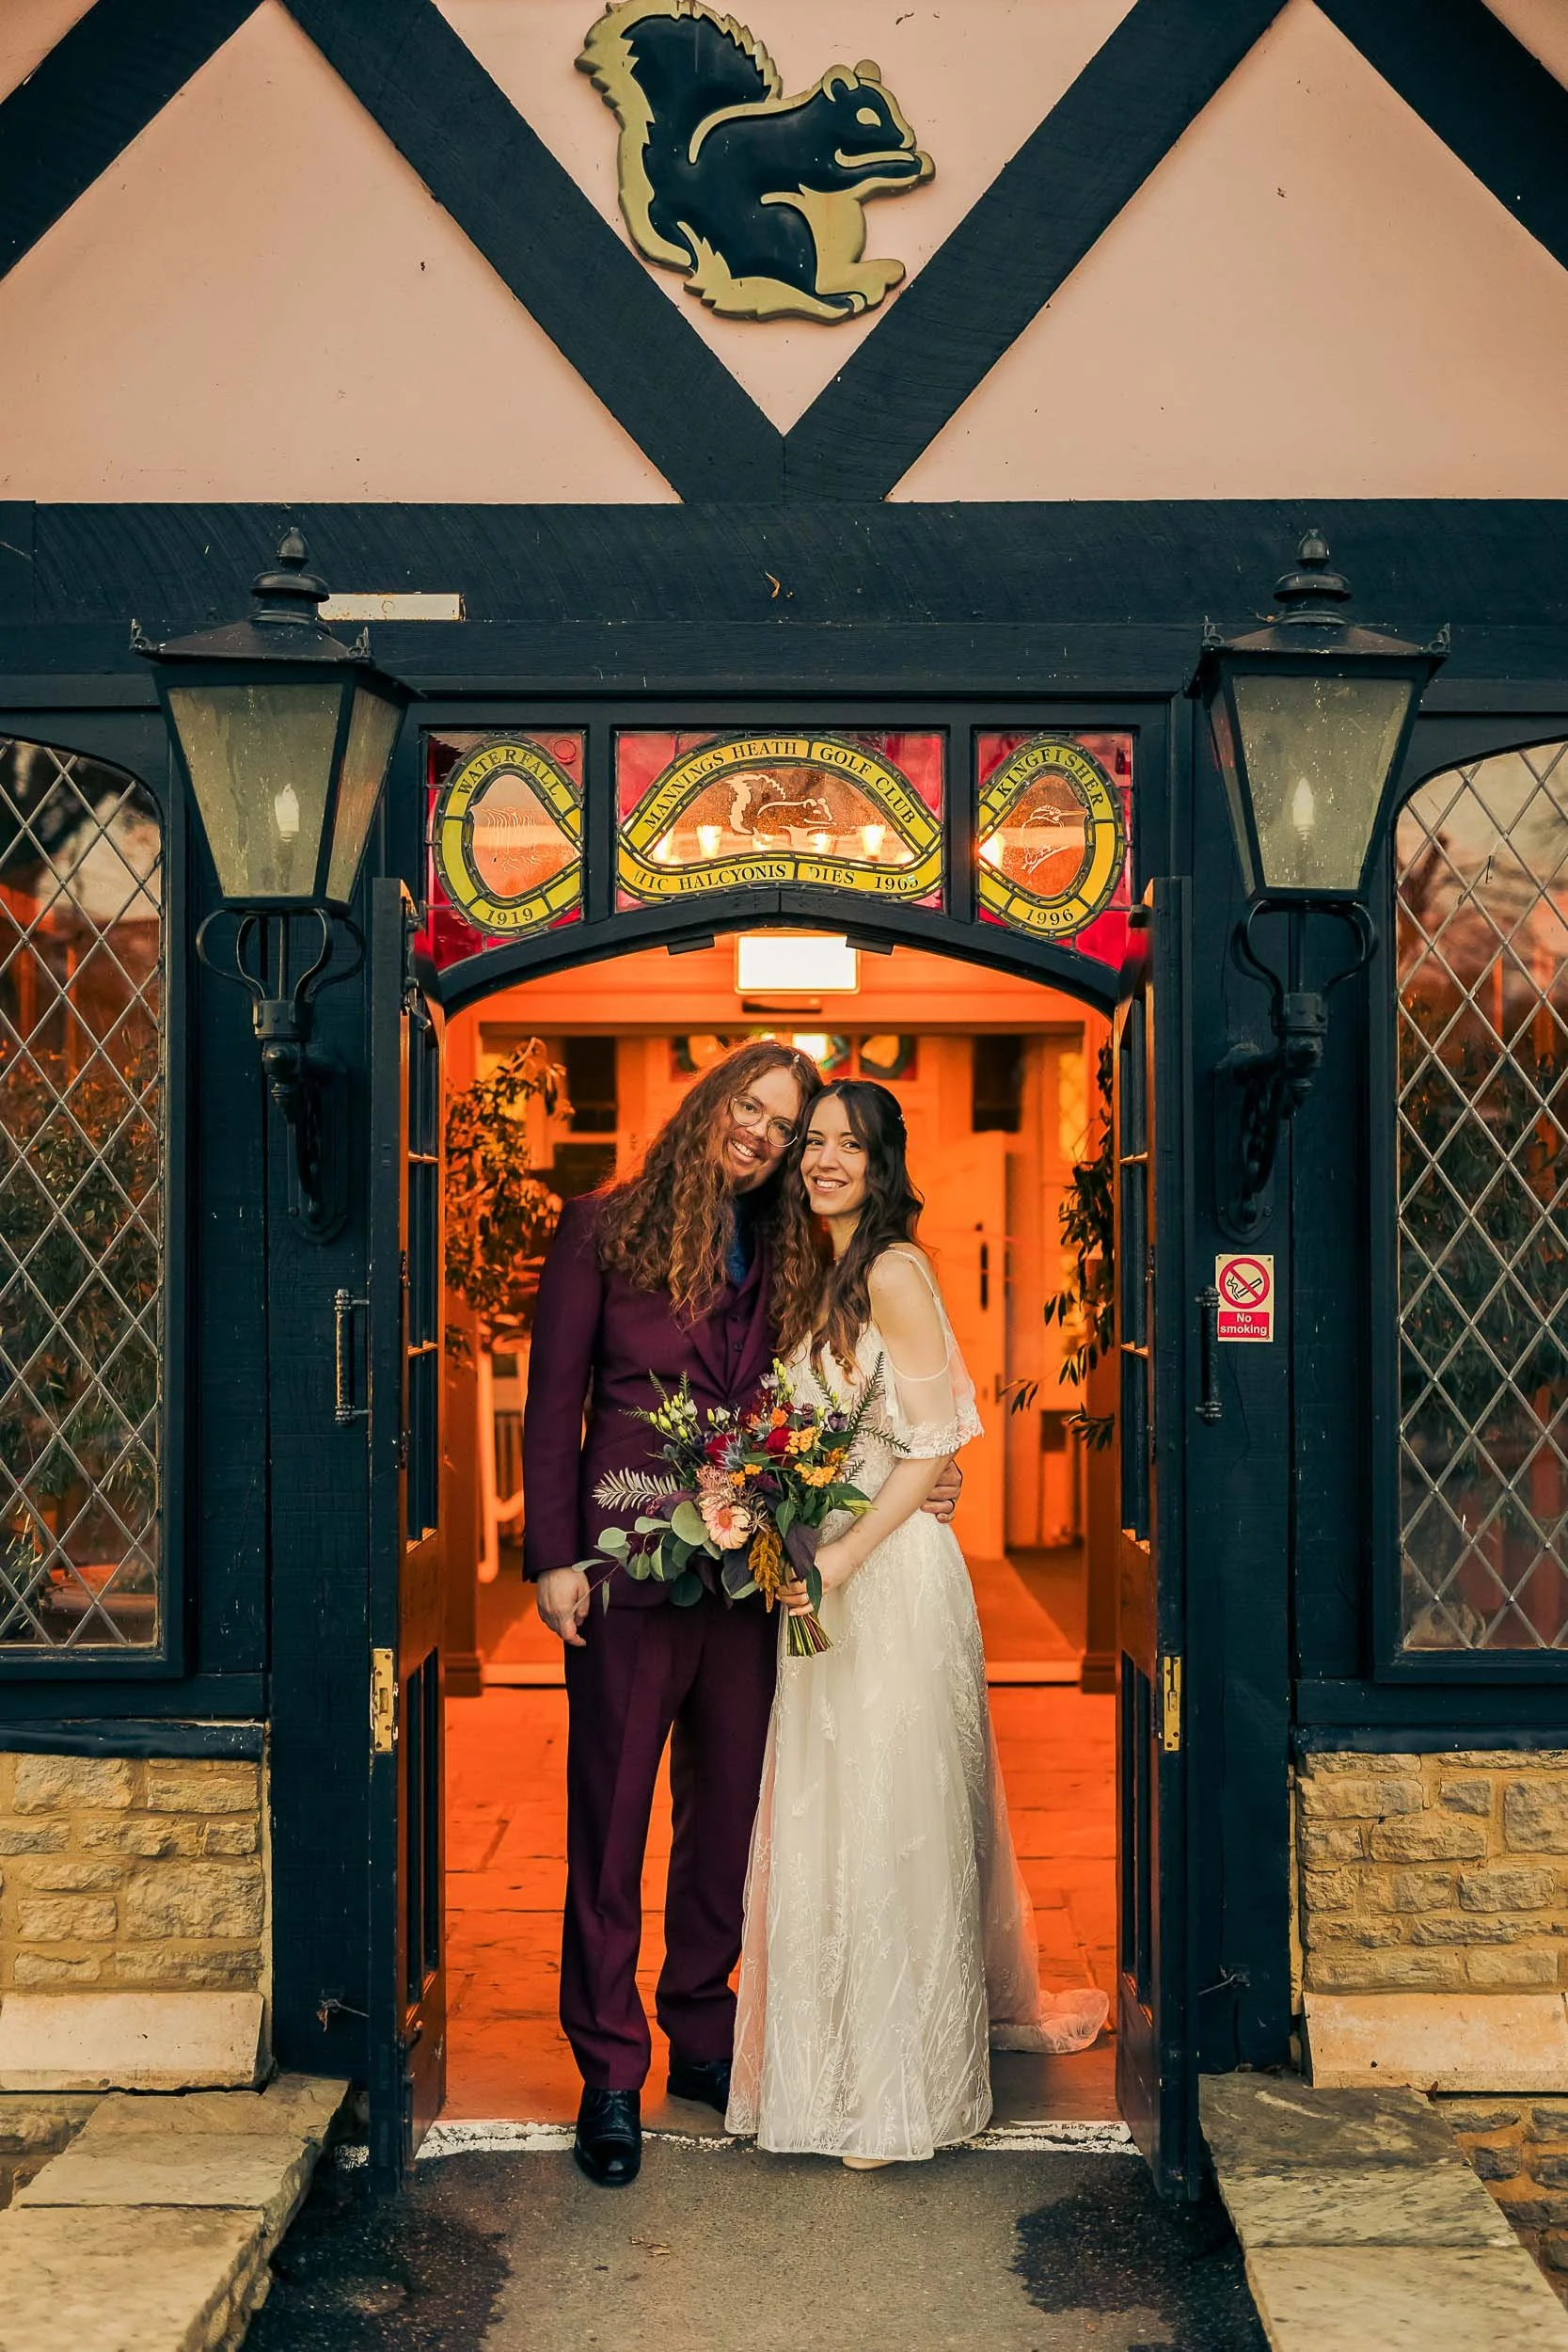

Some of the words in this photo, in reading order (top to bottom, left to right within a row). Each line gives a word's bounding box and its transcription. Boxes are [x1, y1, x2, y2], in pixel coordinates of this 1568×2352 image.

[457, 749, 558, 796] WATERFALL
[996, 748, 1104, 806] KINGFISHER
[644, 752, 724, 830] MANNINGS
[732, 741, 798, 759] HEATH
[819, 747, 872, 776] GOLF
[875, 776, 915, 823] CLUB
[634, 870, 669, 892] HIC
[677, 865, 787, 892] HALCYONIS
[808, 866, 855, 885] DIES
[484, 907, 533, 925] 1919
[1025, 908, 1074, 926] 1996
[1236, 1312, 1252, 1323] No
[1220, 1324, 1267, 1336] smoking
